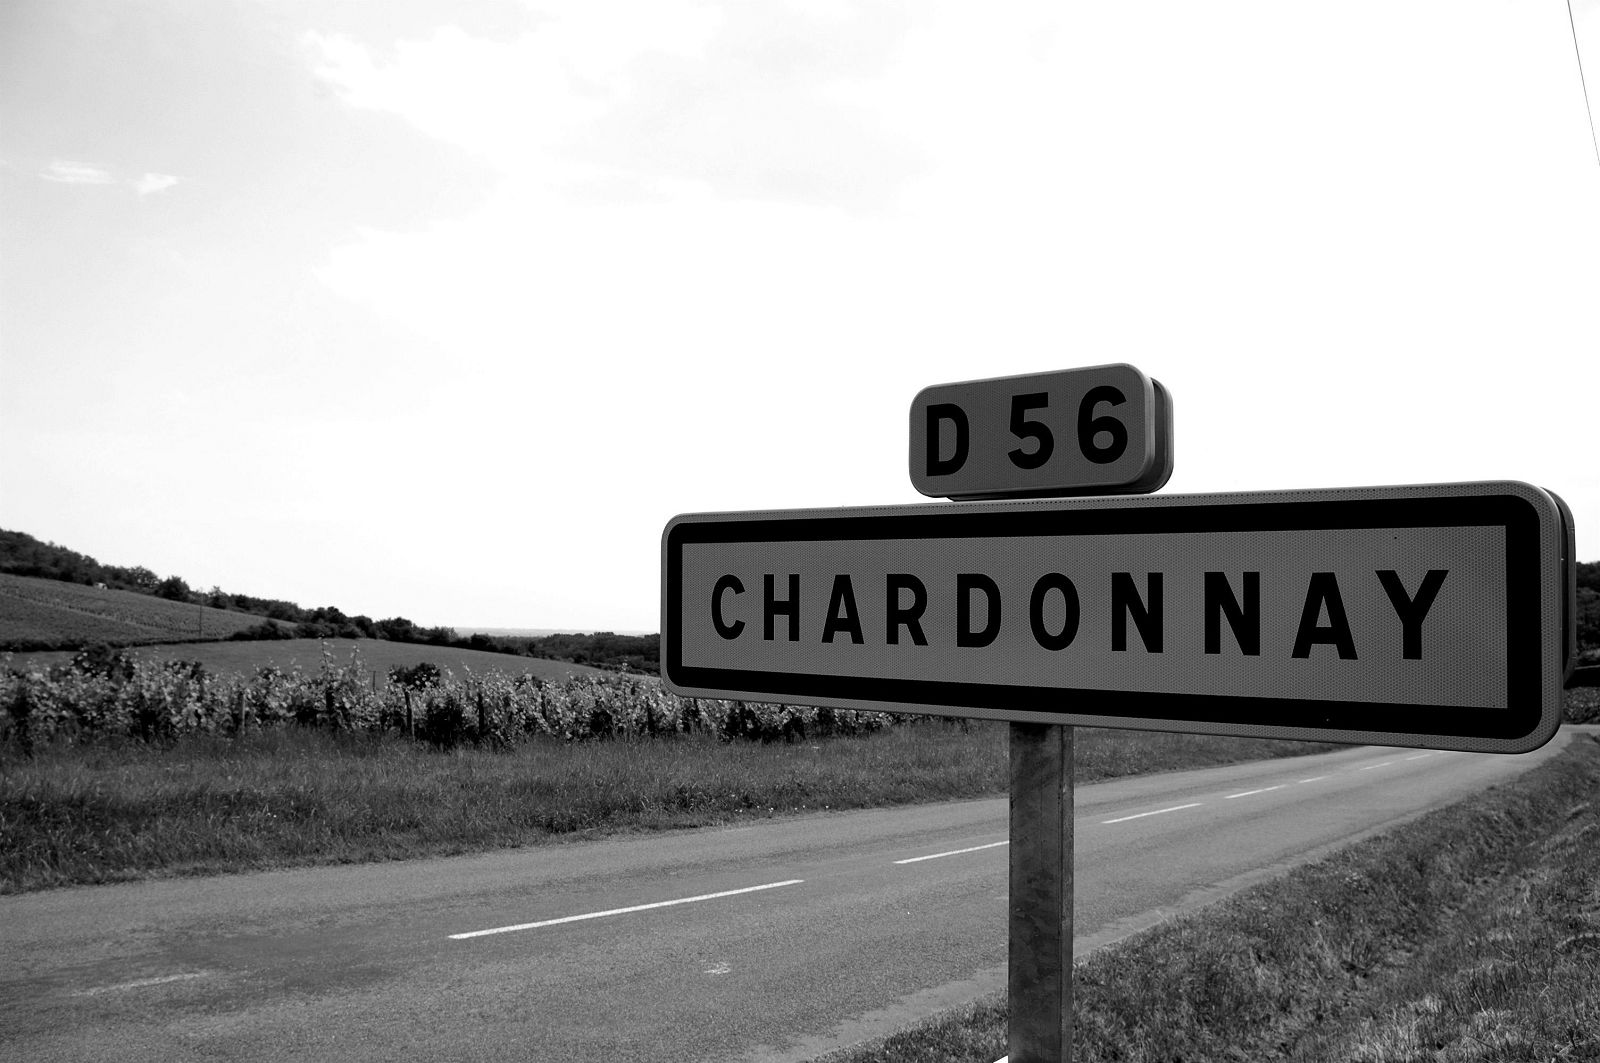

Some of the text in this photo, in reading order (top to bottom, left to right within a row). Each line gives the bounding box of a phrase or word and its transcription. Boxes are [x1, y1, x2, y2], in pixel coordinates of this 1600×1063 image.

[926, 385, 1129, 478] D 56
[711, 569, 1450, 661] CHARDONNAY
